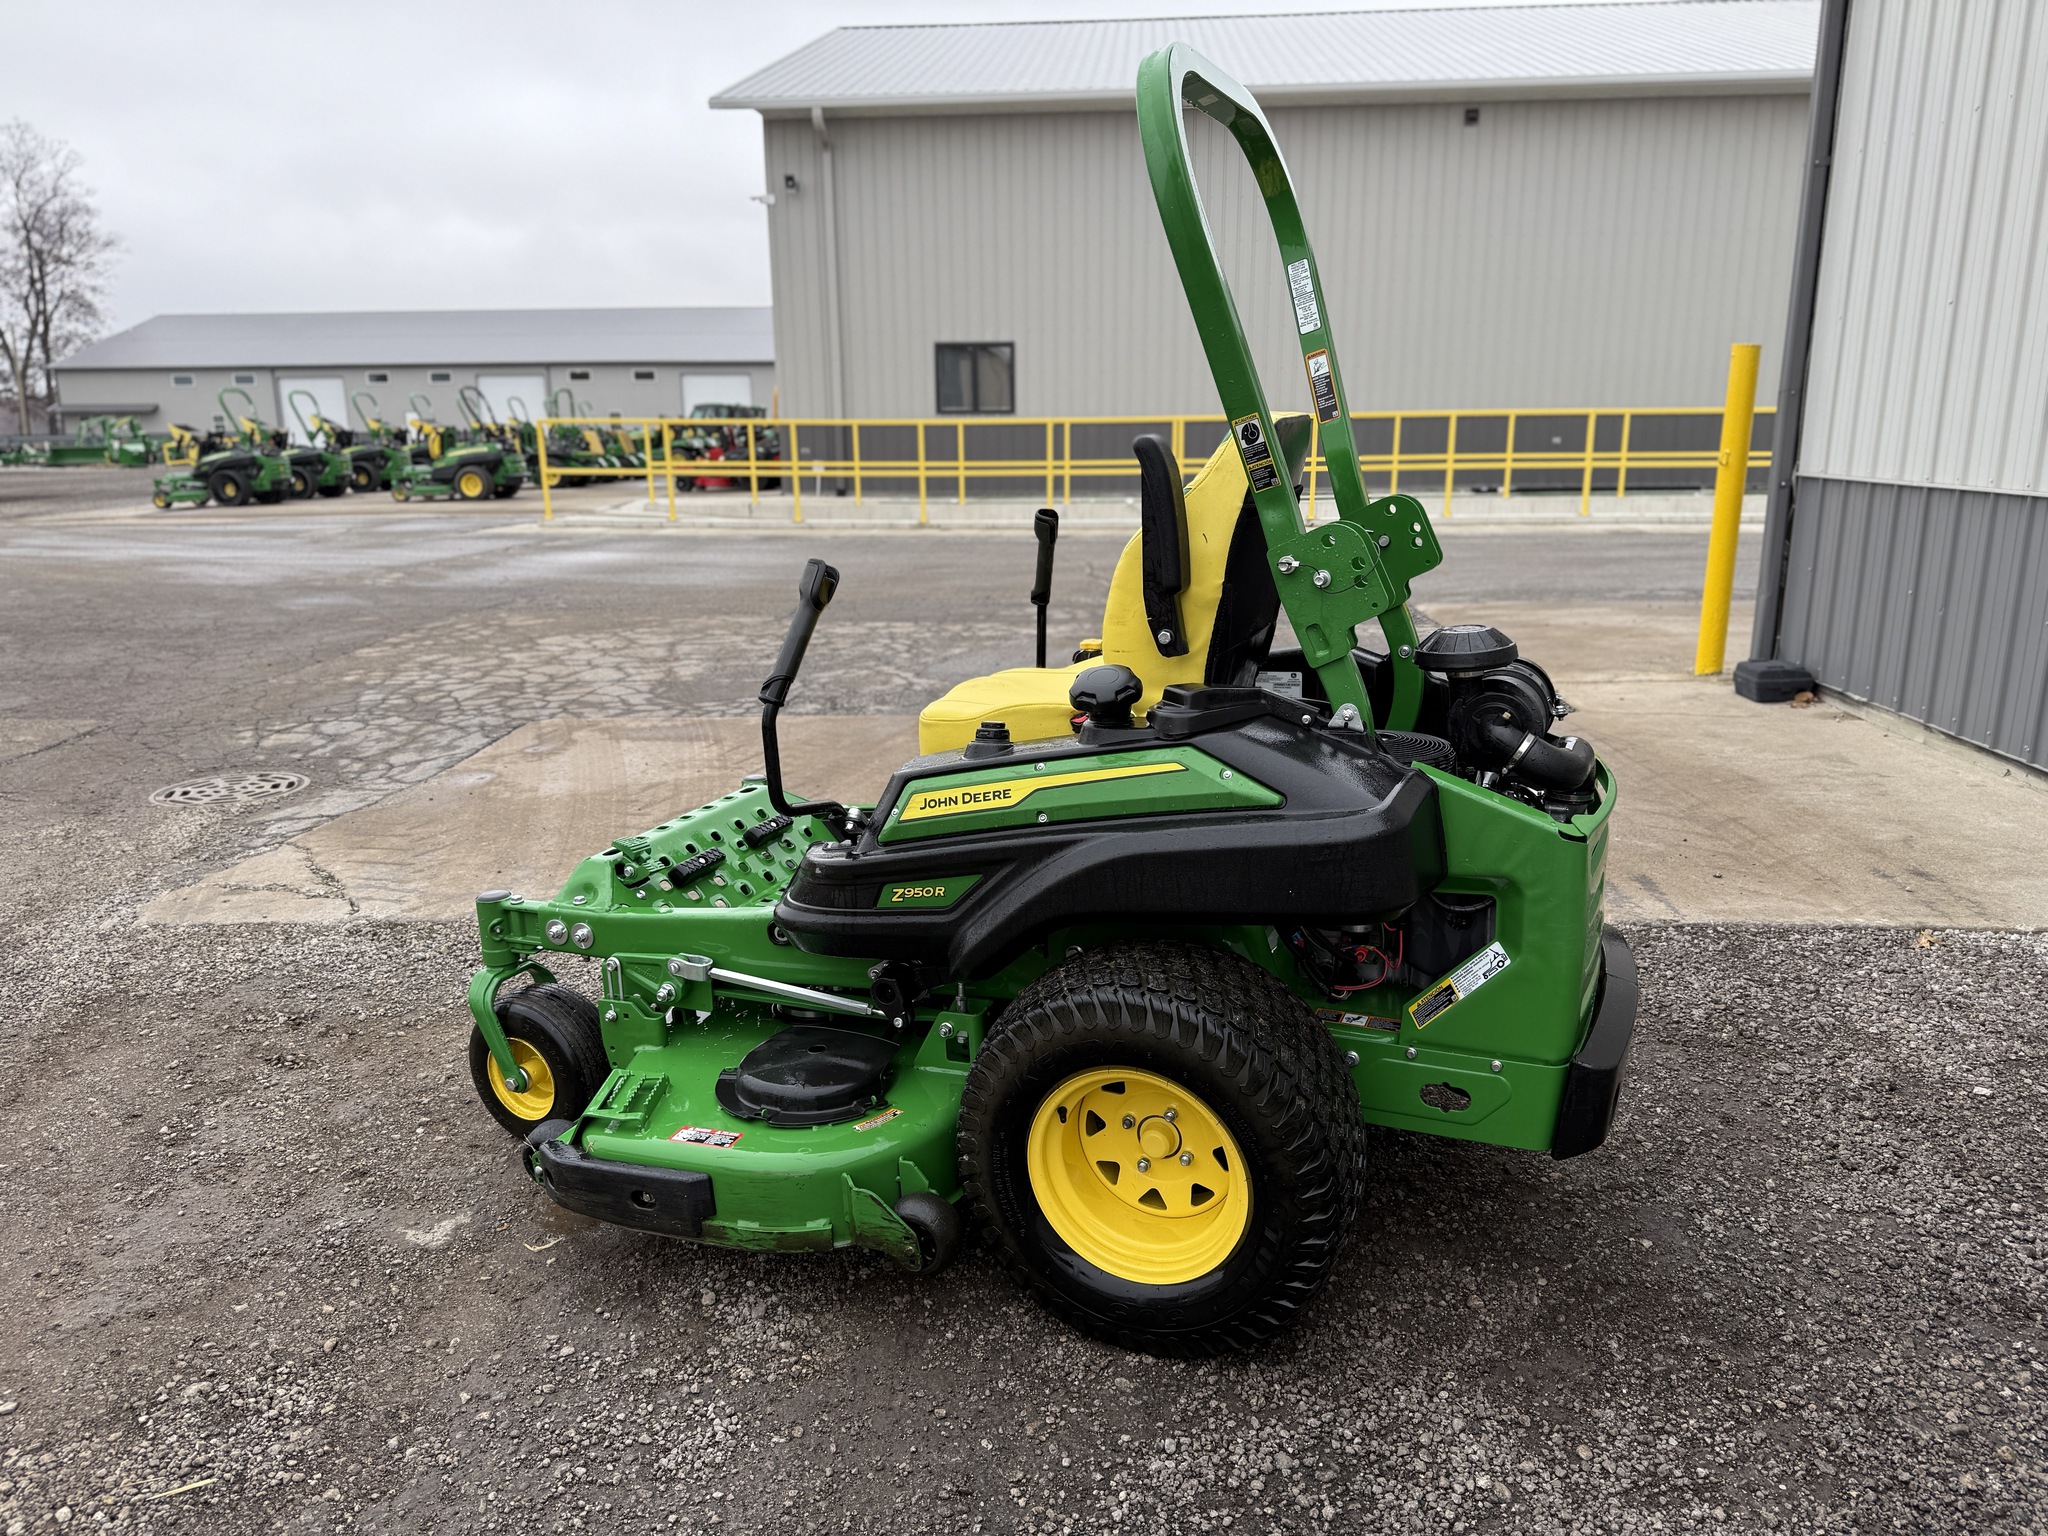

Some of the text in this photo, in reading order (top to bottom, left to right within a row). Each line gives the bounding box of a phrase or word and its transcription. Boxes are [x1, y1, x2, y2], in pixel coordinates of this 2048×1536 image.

[919, 788, 1012, 811] JOHN DEERE
[891, 886, 945, 902] Z950R
